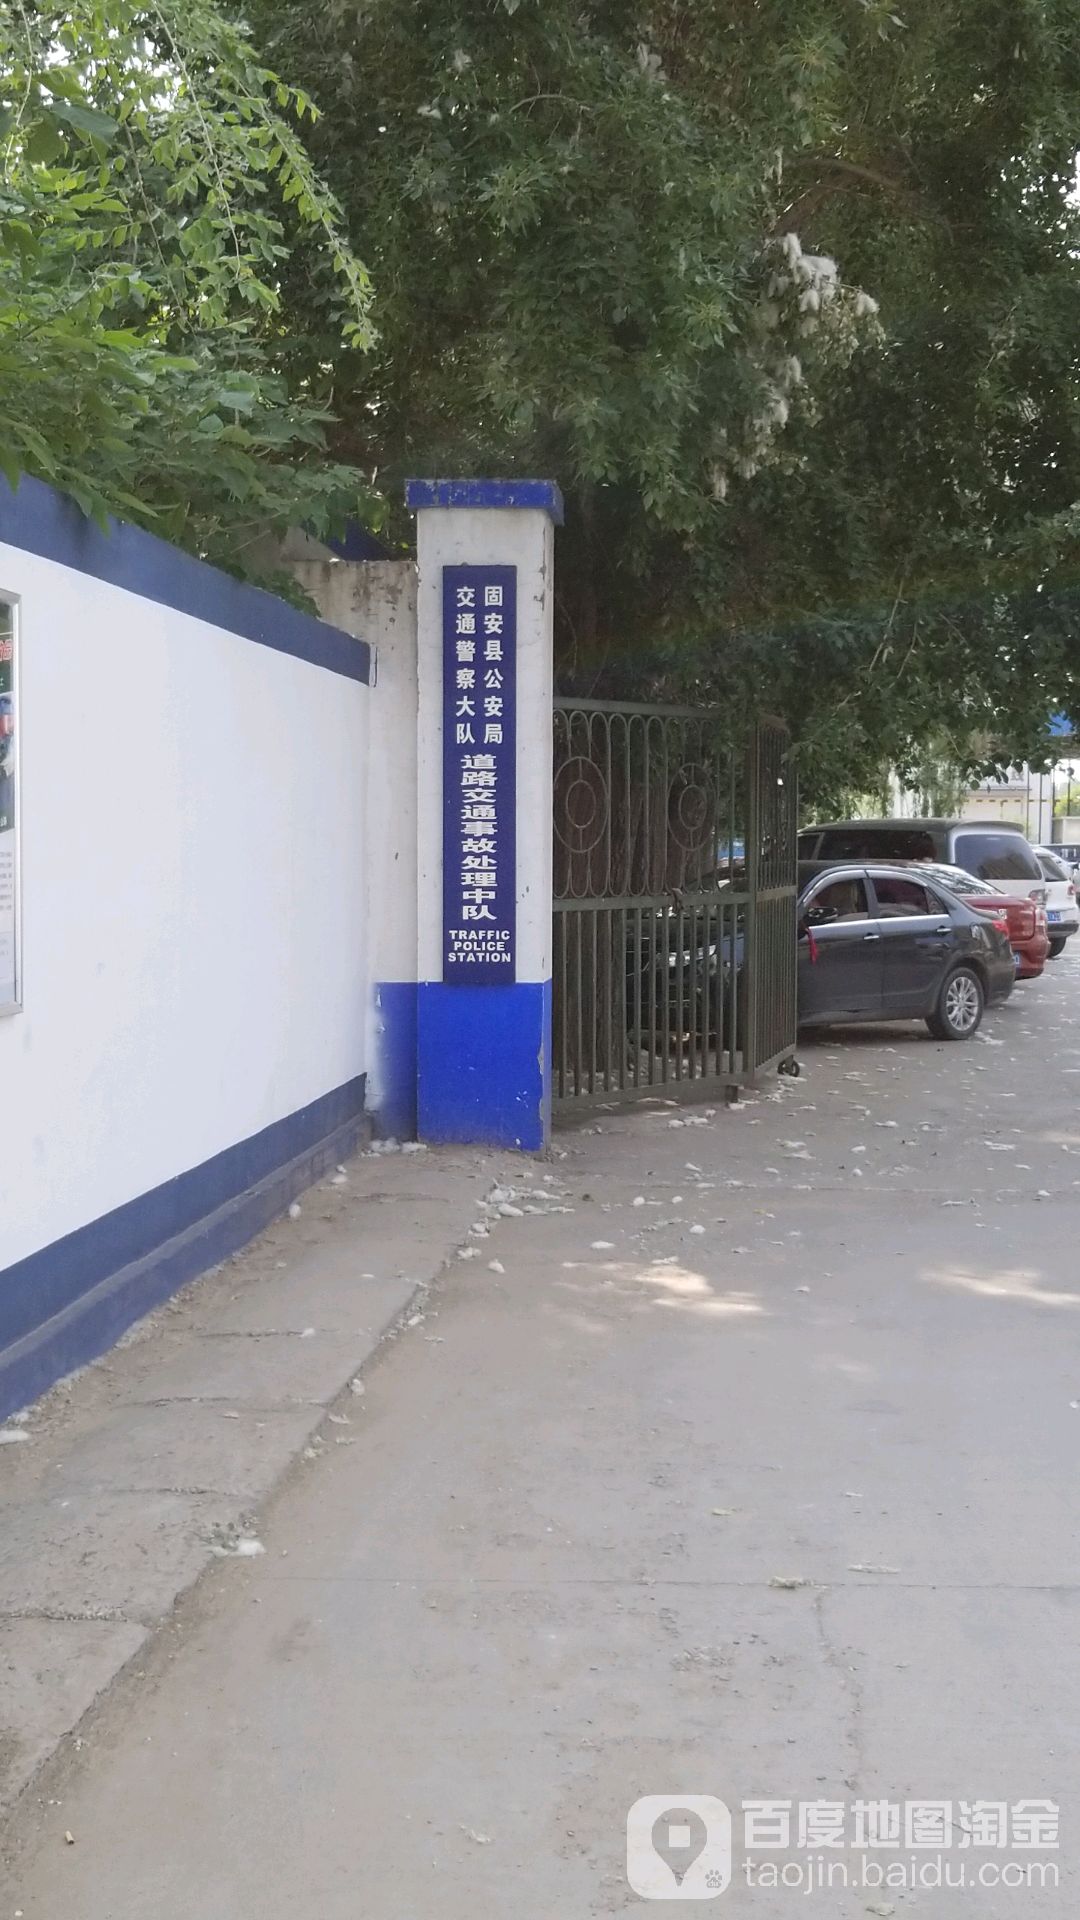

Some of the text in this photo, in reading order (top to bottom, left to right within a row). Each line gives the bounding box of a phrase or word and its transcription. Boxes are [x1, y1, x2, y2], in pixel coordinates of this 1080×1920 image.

[456, 586, 476, 744] 交通警察大队
[484, 586, 503, 744] 固安县公安局
[460, 754, 498, 921] 道路交通事故处理中队
[448, 952, 511, 963] STATION
[449, 930, 511, 940] TRAFFIC
[454, 941, 505, 951] POLICE
